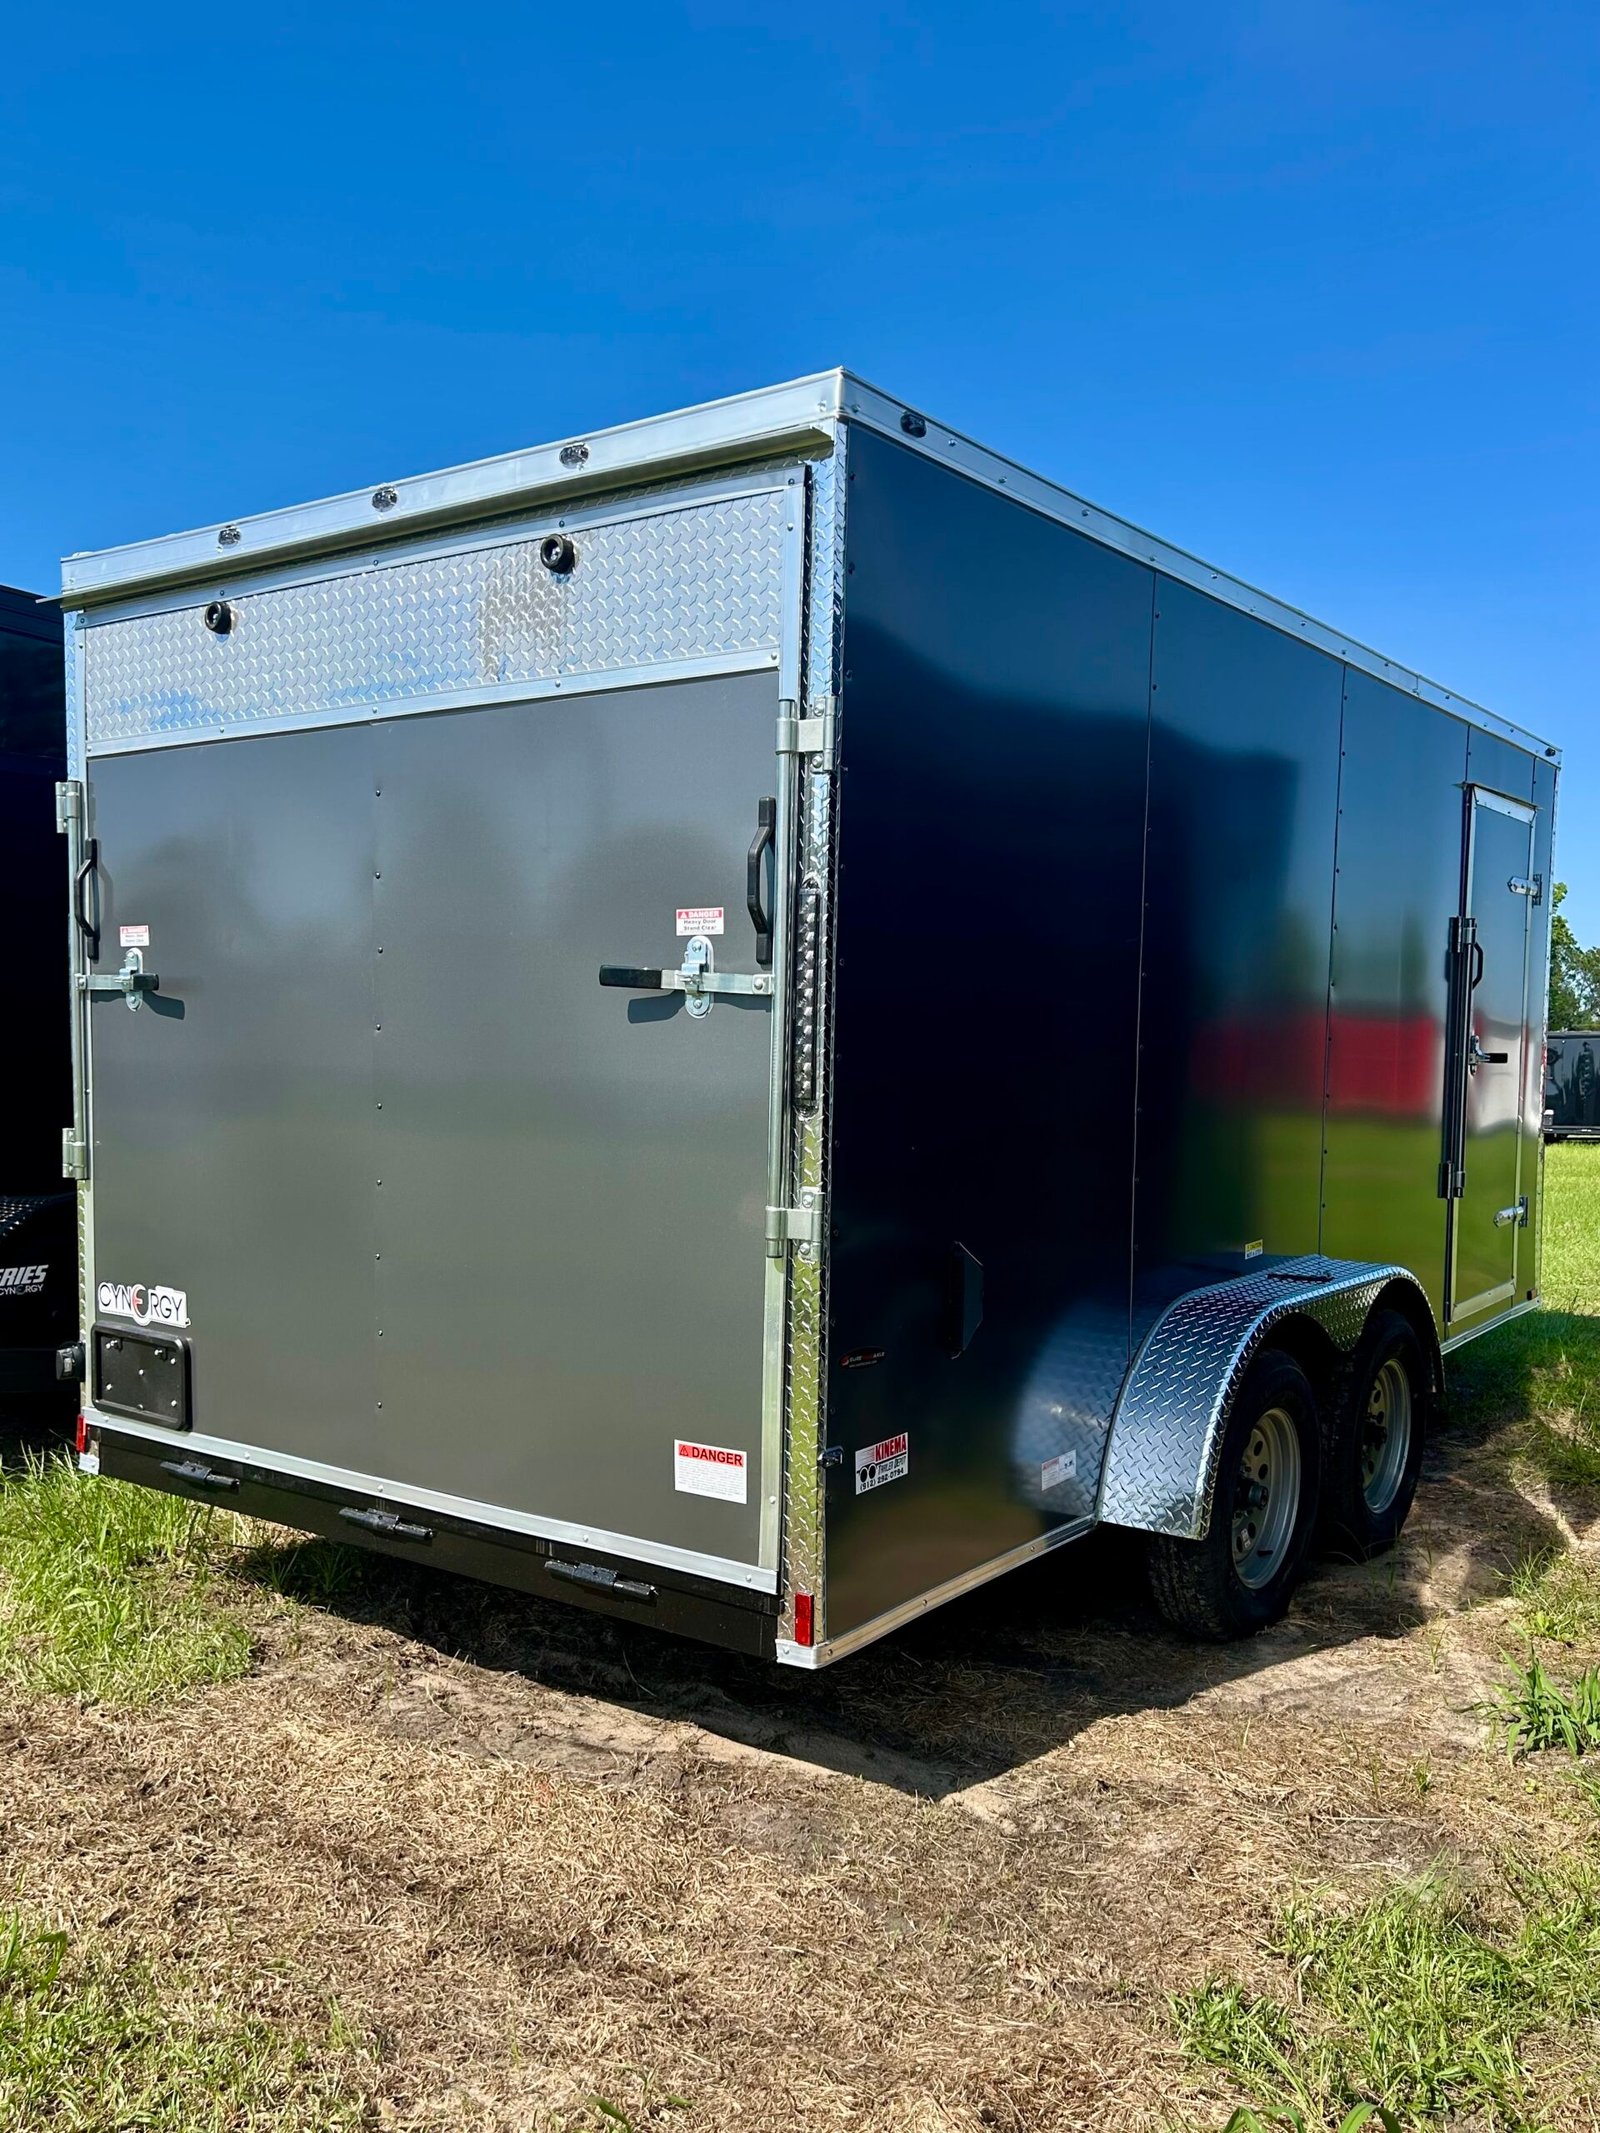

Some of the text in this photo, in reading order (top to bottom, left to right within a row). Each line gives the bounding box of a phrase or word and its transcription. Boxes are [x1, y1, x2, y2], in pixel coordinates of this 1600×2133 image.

[0, 1264, 49, 1287] RIES
[99, 1283, 184, 1321] CYNERGY
[692, 1446, 744, 1468] DANGER
[875, 1434, 907, 1462] KINEMA
